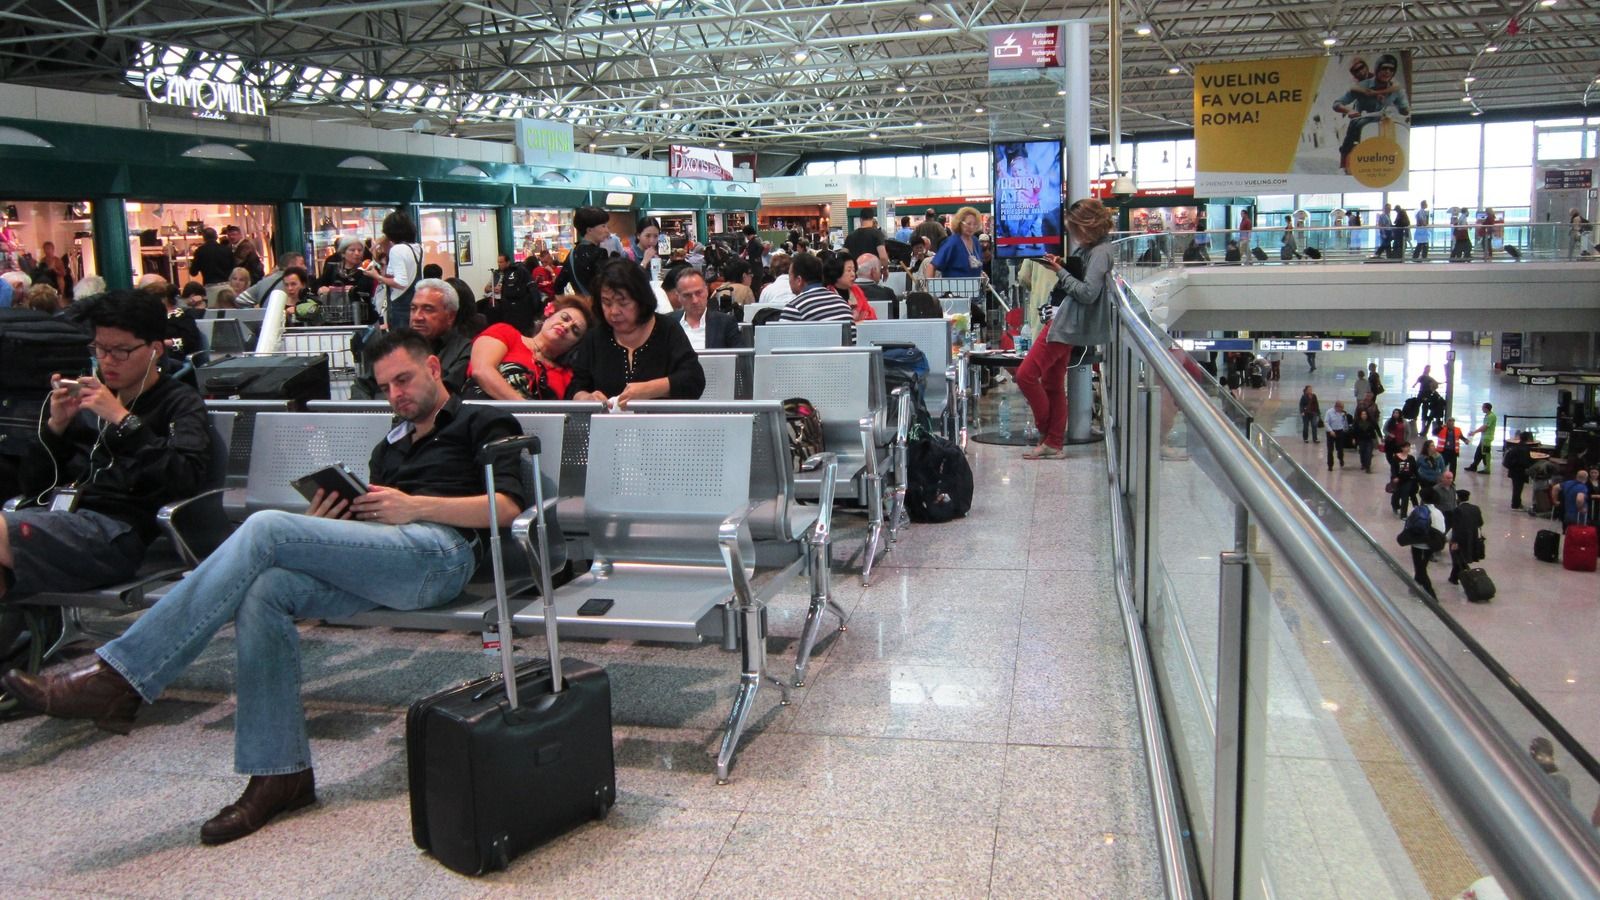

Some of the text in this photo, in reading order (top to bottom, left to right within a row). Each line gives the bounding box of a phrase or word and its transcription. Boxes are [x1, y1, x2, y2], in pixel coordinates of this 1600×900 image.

[1201, 72, 1280, 88] VUELING
[145, 73, 267, 116] CAMOMILLA
[1202, 89, 1302, 107] FA VOLARE
[1202, 111, 1260, 126] ROMA!
[527, 128, 570, 159] carpisa
[1357, 152, 1395, 164] vueling
